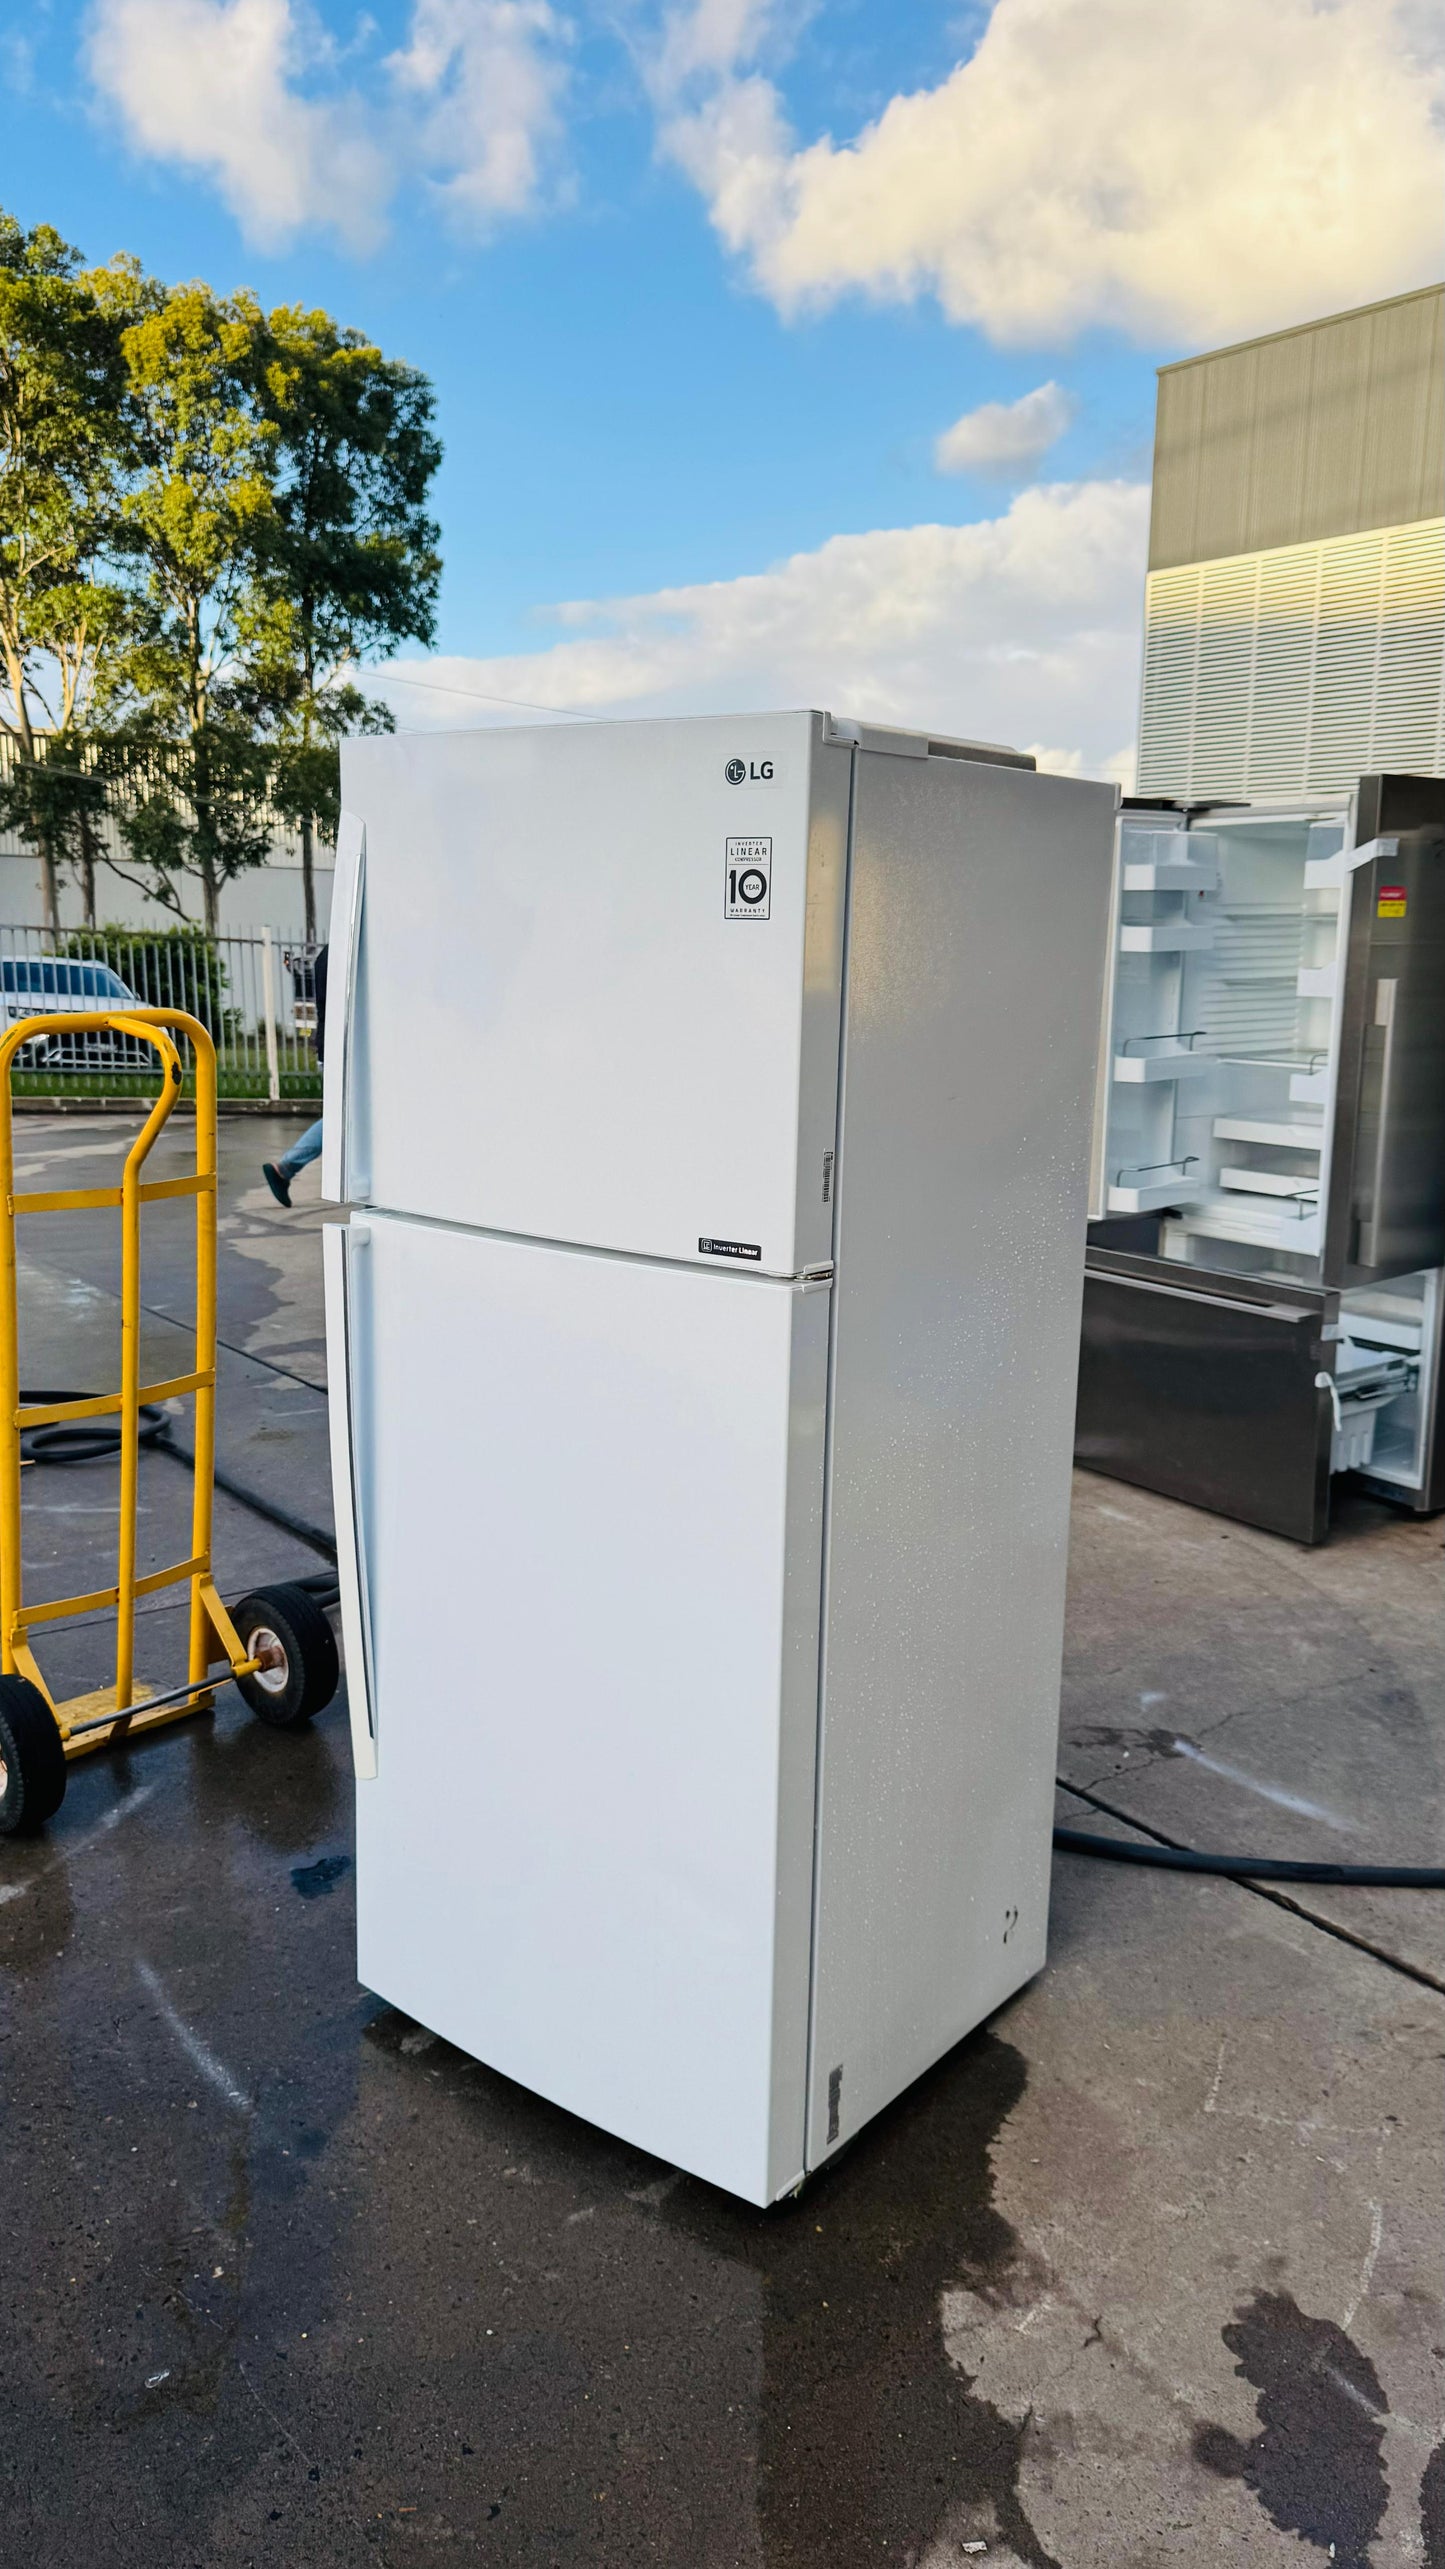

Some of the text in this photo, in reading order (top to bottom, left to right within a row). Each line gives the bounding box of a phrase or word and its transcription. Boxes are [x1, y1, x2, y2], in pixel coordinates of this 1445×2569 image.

[750, 761, 774, 780] LG
[730, 847, 767, 856] LINEAR
[729, 868, 767, 905] 10
[745, 883, 760, 891] YEAR
[713, 1243, 738, 1253] Inverter
